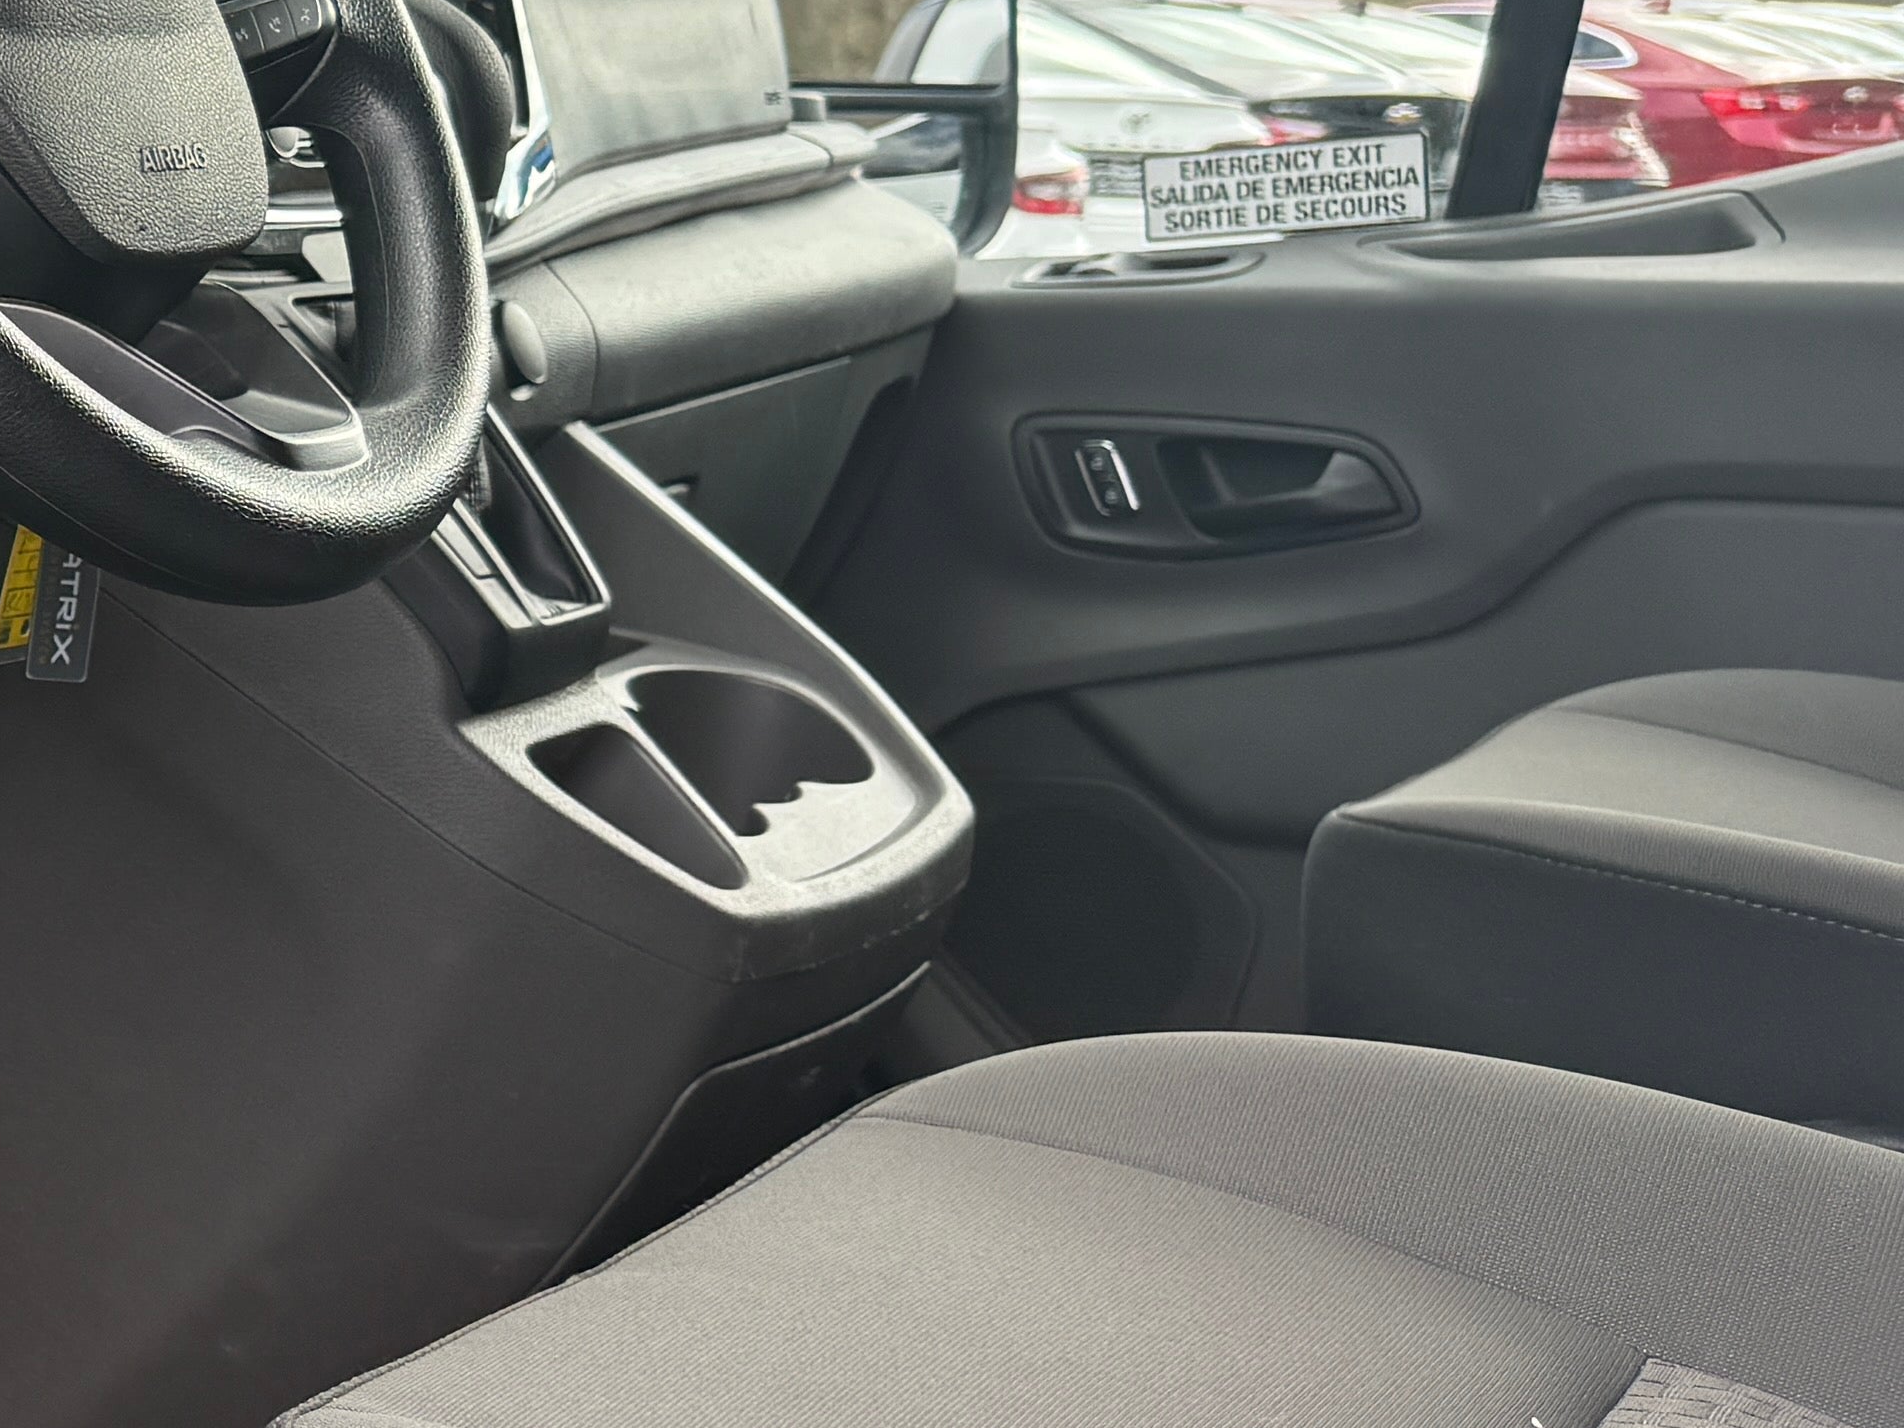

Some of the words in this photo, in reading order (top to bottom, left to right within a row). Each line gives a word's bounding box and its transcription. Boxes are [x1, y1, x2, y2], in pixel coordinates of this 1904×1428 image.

[139, 143, 208, 173] AIRBAG
[1178, 149, 1324, 181] EMERGENCY
[1332, 143, 1387, 169] EXIT
[1150, 181, 1229, 209] SALIDA
[1236, 178, 1267, 200] DE
[1272, 166, 1420, 199] EMERGENCIA
[1164, 206, 1248, 233] SORTIE
[1256, 202, 1288, 225] DE
[1294, 192, 1407, 222] SECOURS
